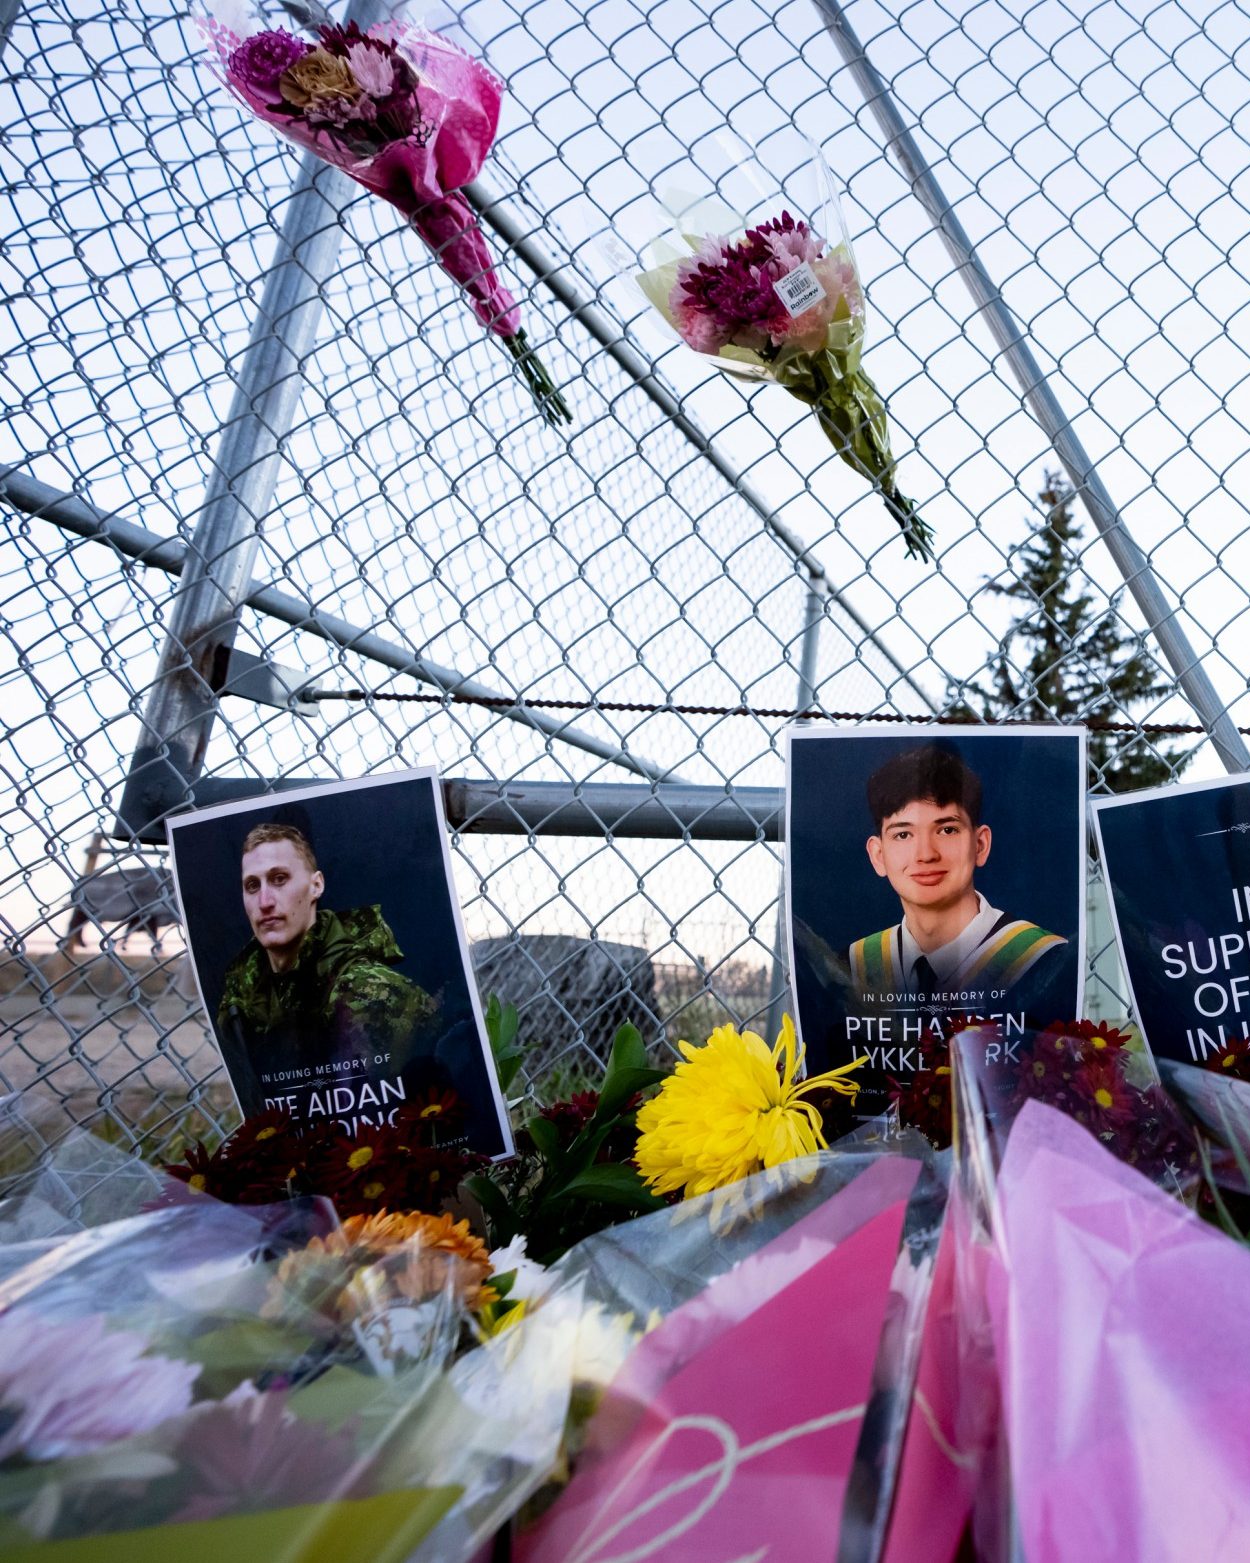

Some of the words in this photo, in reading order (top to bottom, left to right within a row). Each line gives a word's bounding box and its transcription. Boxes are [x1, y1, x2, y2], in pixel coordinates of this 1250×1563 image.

[790, 287, 819, 310] Rainbow
[862, 993, 875, 1002] IN
[880, 992, 926, 1002] LOVING
[931, 990, 985, 1002] MEMORY
[990, 989, 1007, 999] OF
[1193, 975, 1250, 1017] OF
[845, 1016, 892, 1042] PTE
[261, 1074, 271, 1083] IN
[273, 1068, 311, 1082] LOVING
[315, 1057, 368, 1075] MEMORY
[374, 1053, 391, 1064] OF
[308, 1076, 406, 1118] AIDAN
